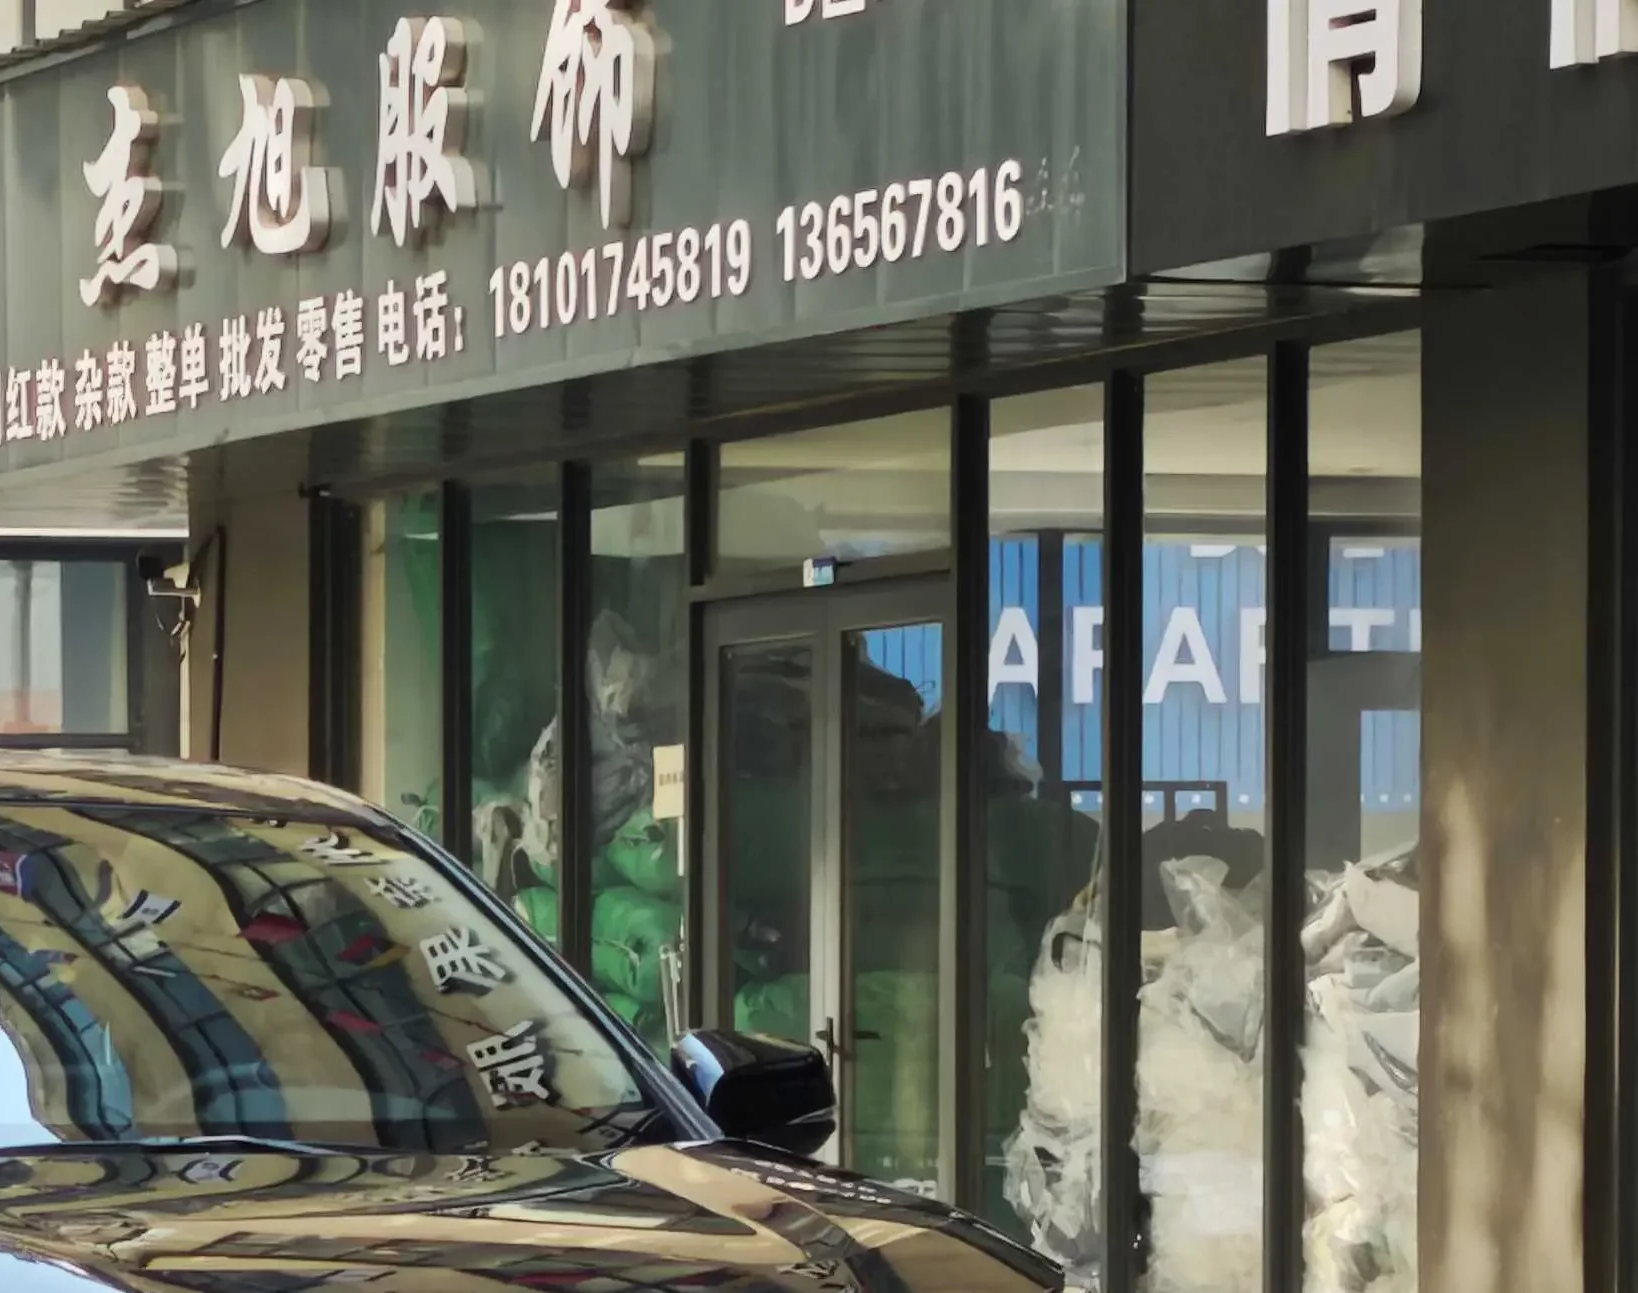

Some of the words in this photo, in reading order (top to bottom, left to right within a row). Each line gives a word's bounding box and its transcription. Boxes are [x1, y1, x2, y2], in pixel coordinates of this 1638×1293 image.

[74, 330, 137, 431] 杂款
[145, 321, 209, 416] 整单
[219, 305, 286, 402] 批发
[297, 288, 365, 383] 零售
[377, 269, 464, 366] 电话：
[489, 219, 752, 338] 18101745819
